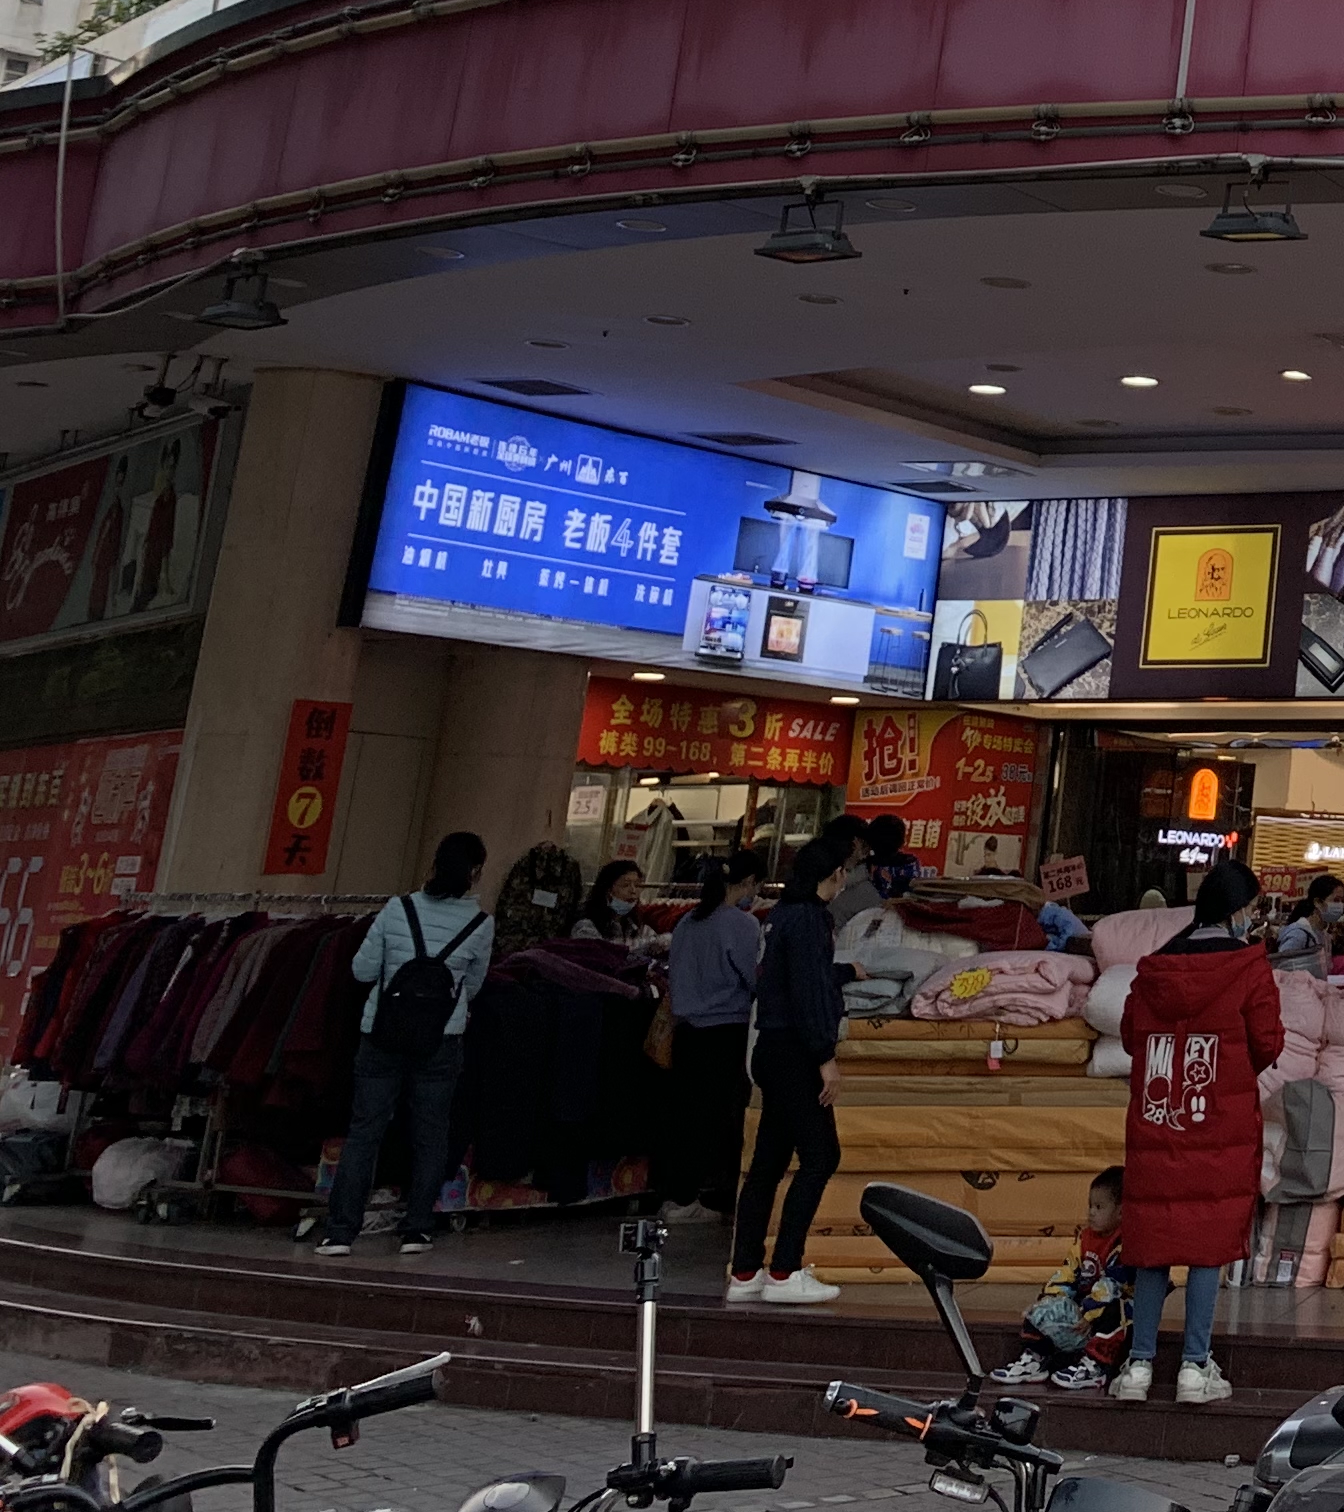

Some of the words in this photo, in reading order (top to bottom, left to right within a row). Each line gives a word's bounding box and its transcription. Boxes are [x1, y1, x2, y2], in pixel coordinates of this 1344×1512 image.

[412, 479, 547, 542] 中国新厨房
[563, 508, 683, 566] 老板4件套
[1167, 606, 1255, 620] LEONARDO
[788, 717, 841, 742] SALE
[1158, 829, 1225, 848] LEONARDO
[1048, 875, 1072, 893] 168
[1143, 1103, 1165, 1125] 28
